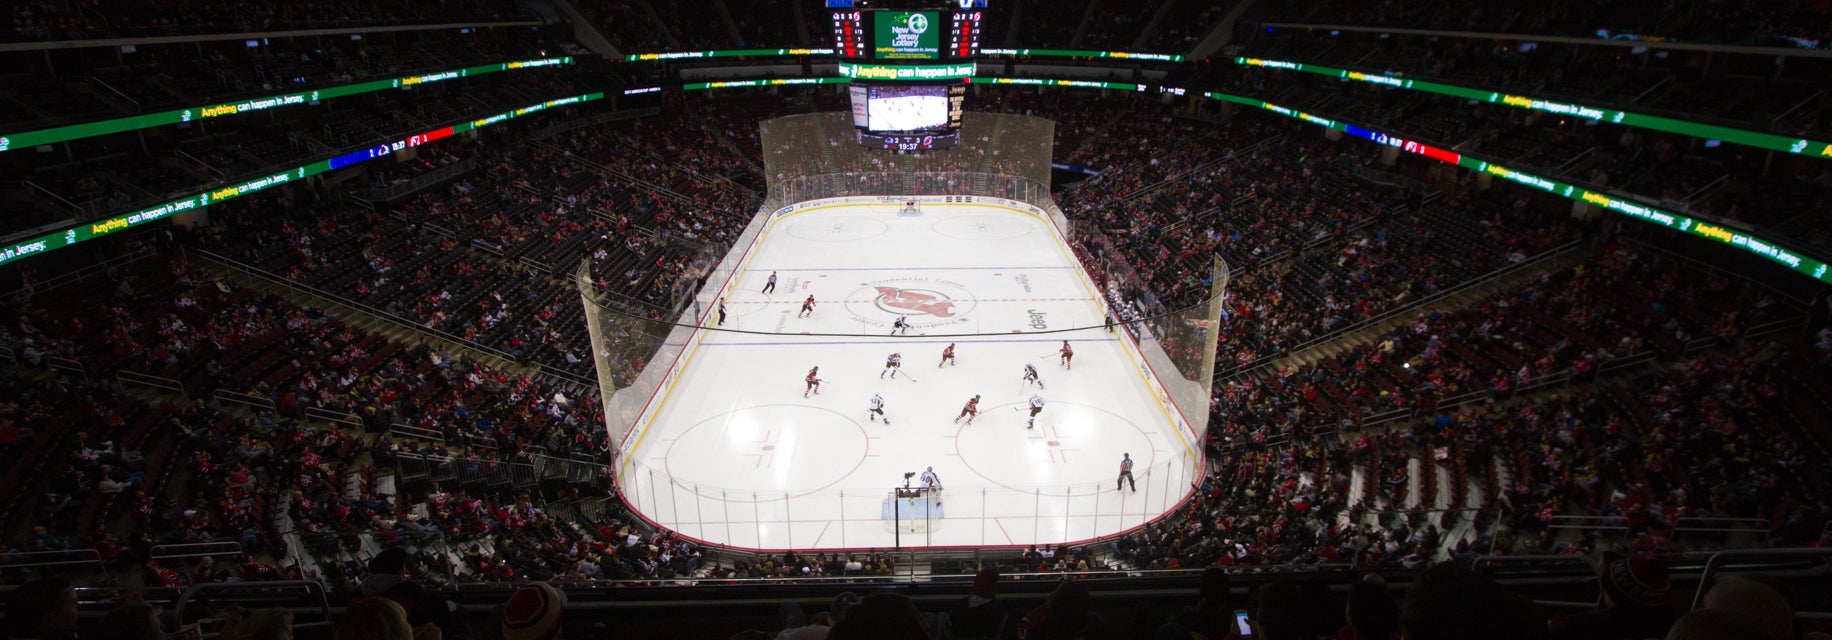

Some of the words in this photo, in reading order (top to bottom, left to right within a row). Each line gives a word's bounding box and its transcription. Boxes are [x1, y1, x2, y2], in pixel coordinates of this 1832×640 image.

[892, 39, 918, 48] Lottery
[896, 33, 919, 42] Jersey
[858, 66, 898, 80] Anything
[898, 68, 914, 77] can
[915, 67, 946, 78] happen
[948, 66, 954, 76] in
[201, 104, 237, 117] Anything
[237, 103, 250, 112] can
[250, 98, 276, 110] happen
[276, 96, 283, 105] in
[1504, 94, 1532, 108] Anything
[1544, 100, 1570, 114] happen
[1570, 104, 1578, 114] in
[238, 184, 248, 193] can
[248, 180, 268, 191] happen
[776, 206, 794, 218] GEICO
[1583, 191, 1610, 208] Anything
[1609, 200, 1620, 208] can
[1620, 200, 1644, 216] happen
[1644, 207, 1651, 218] in
[92, 218, 128, 234] Anything
[128, 214, 142, 224] can
[140, 206, 168, 221] happen
[166, 204, 174, 213] in
[1695, 223, 1733, 242] Anything
[1732, 234, 1748, 246] can
[1747, 236, 1772, 254] happen
[1770, 246, 1778, 257] in
[4, 248, 16, 259] in
[1027, 309, 1048, 330] Jeep
